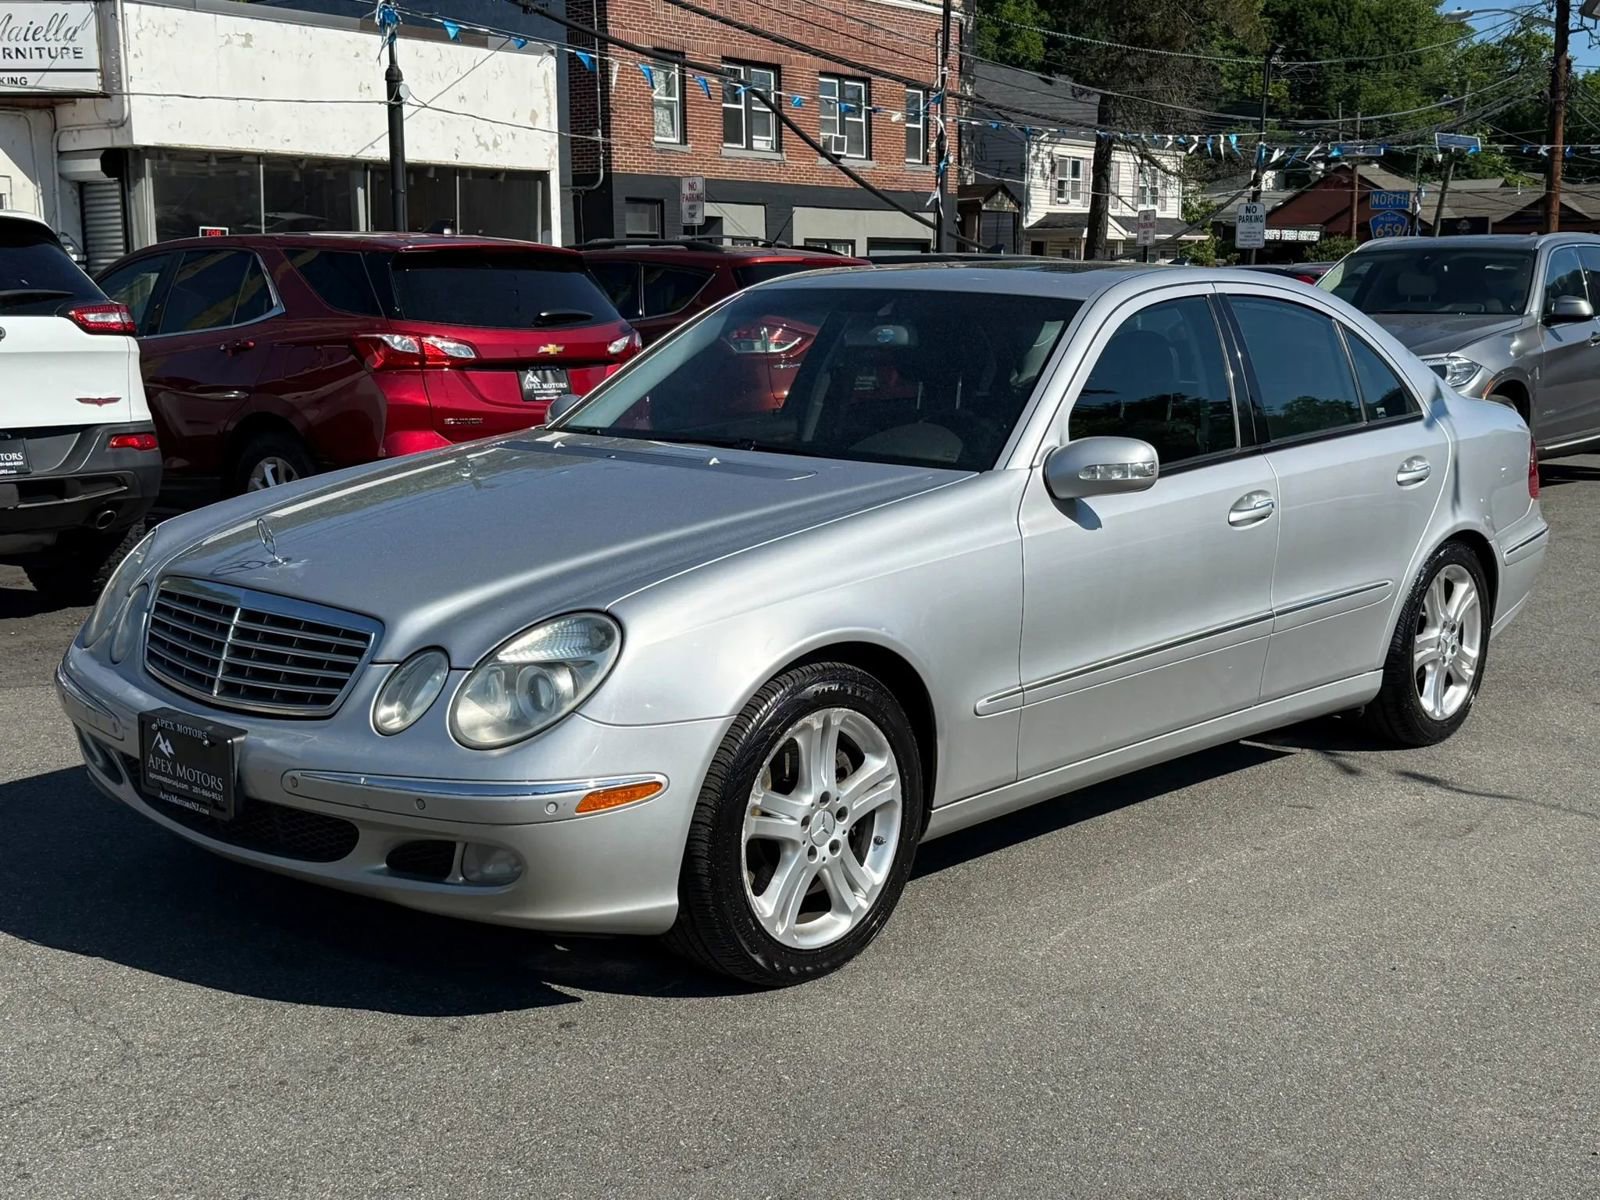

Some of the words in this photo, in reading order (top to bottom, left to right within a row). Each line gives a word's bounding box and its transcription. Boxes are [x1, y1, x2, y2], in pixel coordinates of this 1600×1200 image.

[688, 181, 697, 192] NO
[680, 192, 704, 203] PARKING
[1372, 193, 1408, 206] NORTH
[1245, 205, 1258, 214] NO
[1238, 215, 1264, 224] PARKING
[1375, 223, 1403, 238] 659
[156, 718, 175, 731] APEX
[177, 724, 208, 740] MOTORS
[148, 753, 173, 775] APEX
[176, 761, 224, 792] MOTORS
